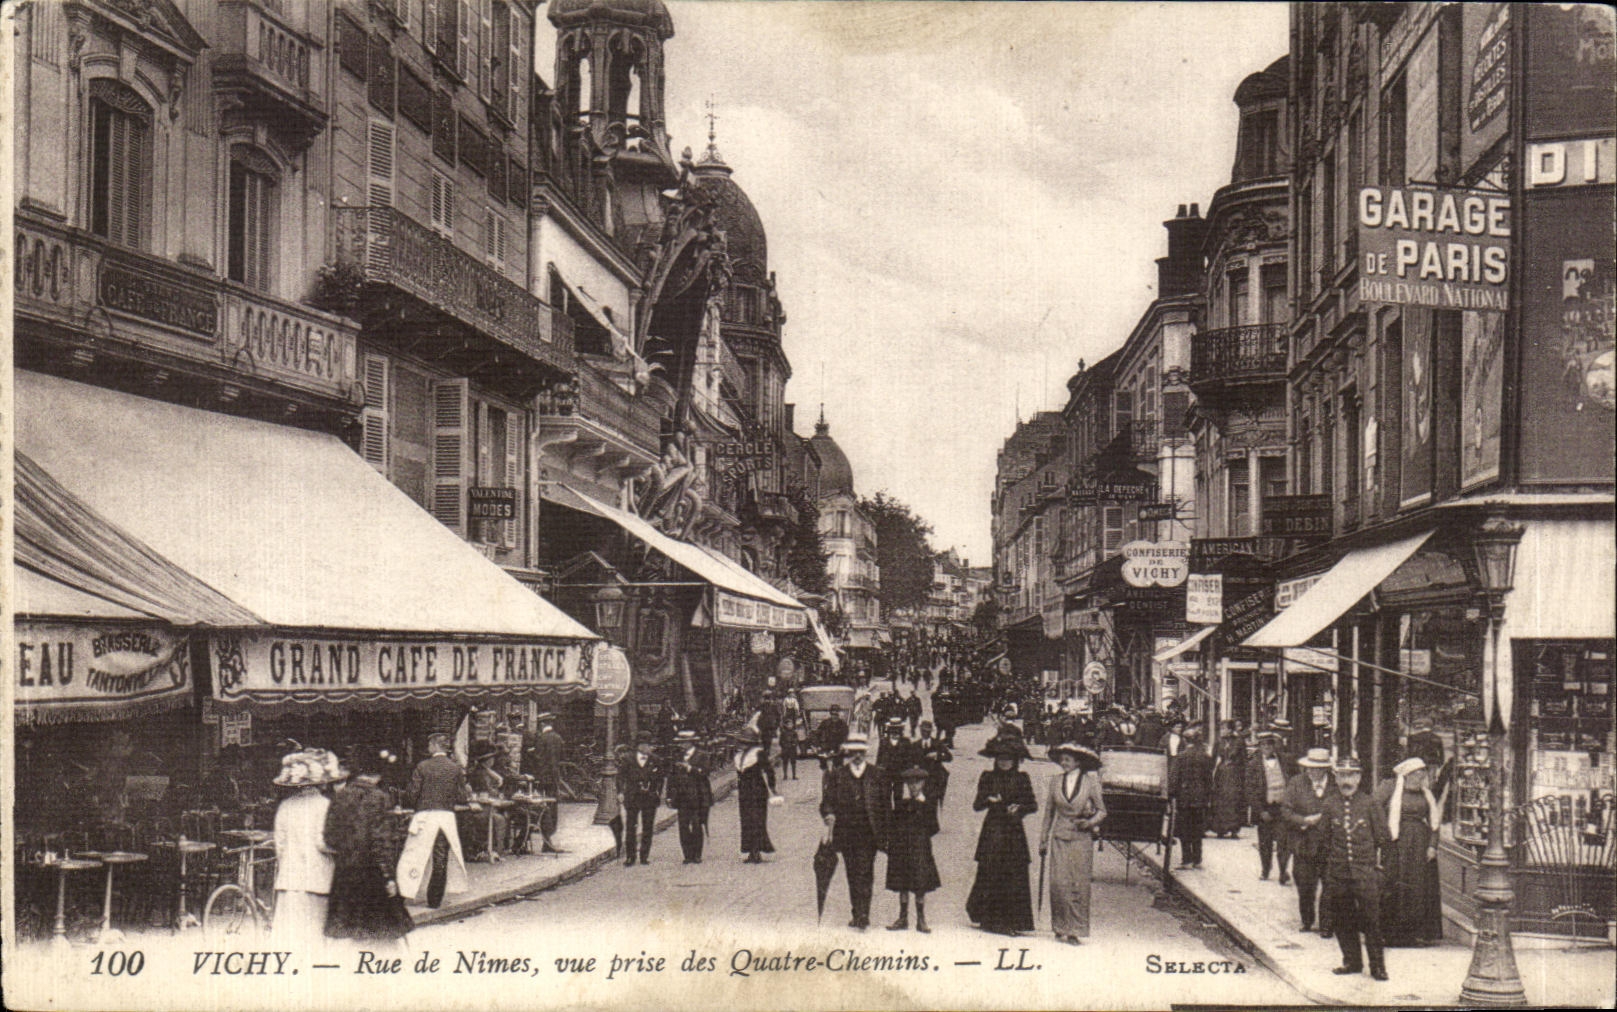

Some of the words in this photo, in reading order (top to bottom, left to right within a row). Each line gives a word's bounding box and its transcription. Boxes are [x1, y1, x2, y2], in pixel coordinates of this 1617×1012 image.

[1359, 187, 1511, 237] GARAGE
[1366, 252, 1387, 275] DE
[1396, 240, 1507, 285] PARIS
[1359, 278, 1439, 305] BOULEVARD
[716, 442, 773, 455] CERCLE
[722, 456, 773, 485] SPORTS
[471, 488, 514, 499] VALENTINE
[473, 503, 512, 517] MODES
[1126, 548, 1186, 558] CONFISERIE
[1133, 567, 1180, 579] VICHY
[19, 641, 74, 687] EAU
[269, 642, 361, 685] GRAND
[378, 645, 437, 683] CAFE
[452, 645, 479, 682] DE
[492, 646, 566, 682] FRANCE
